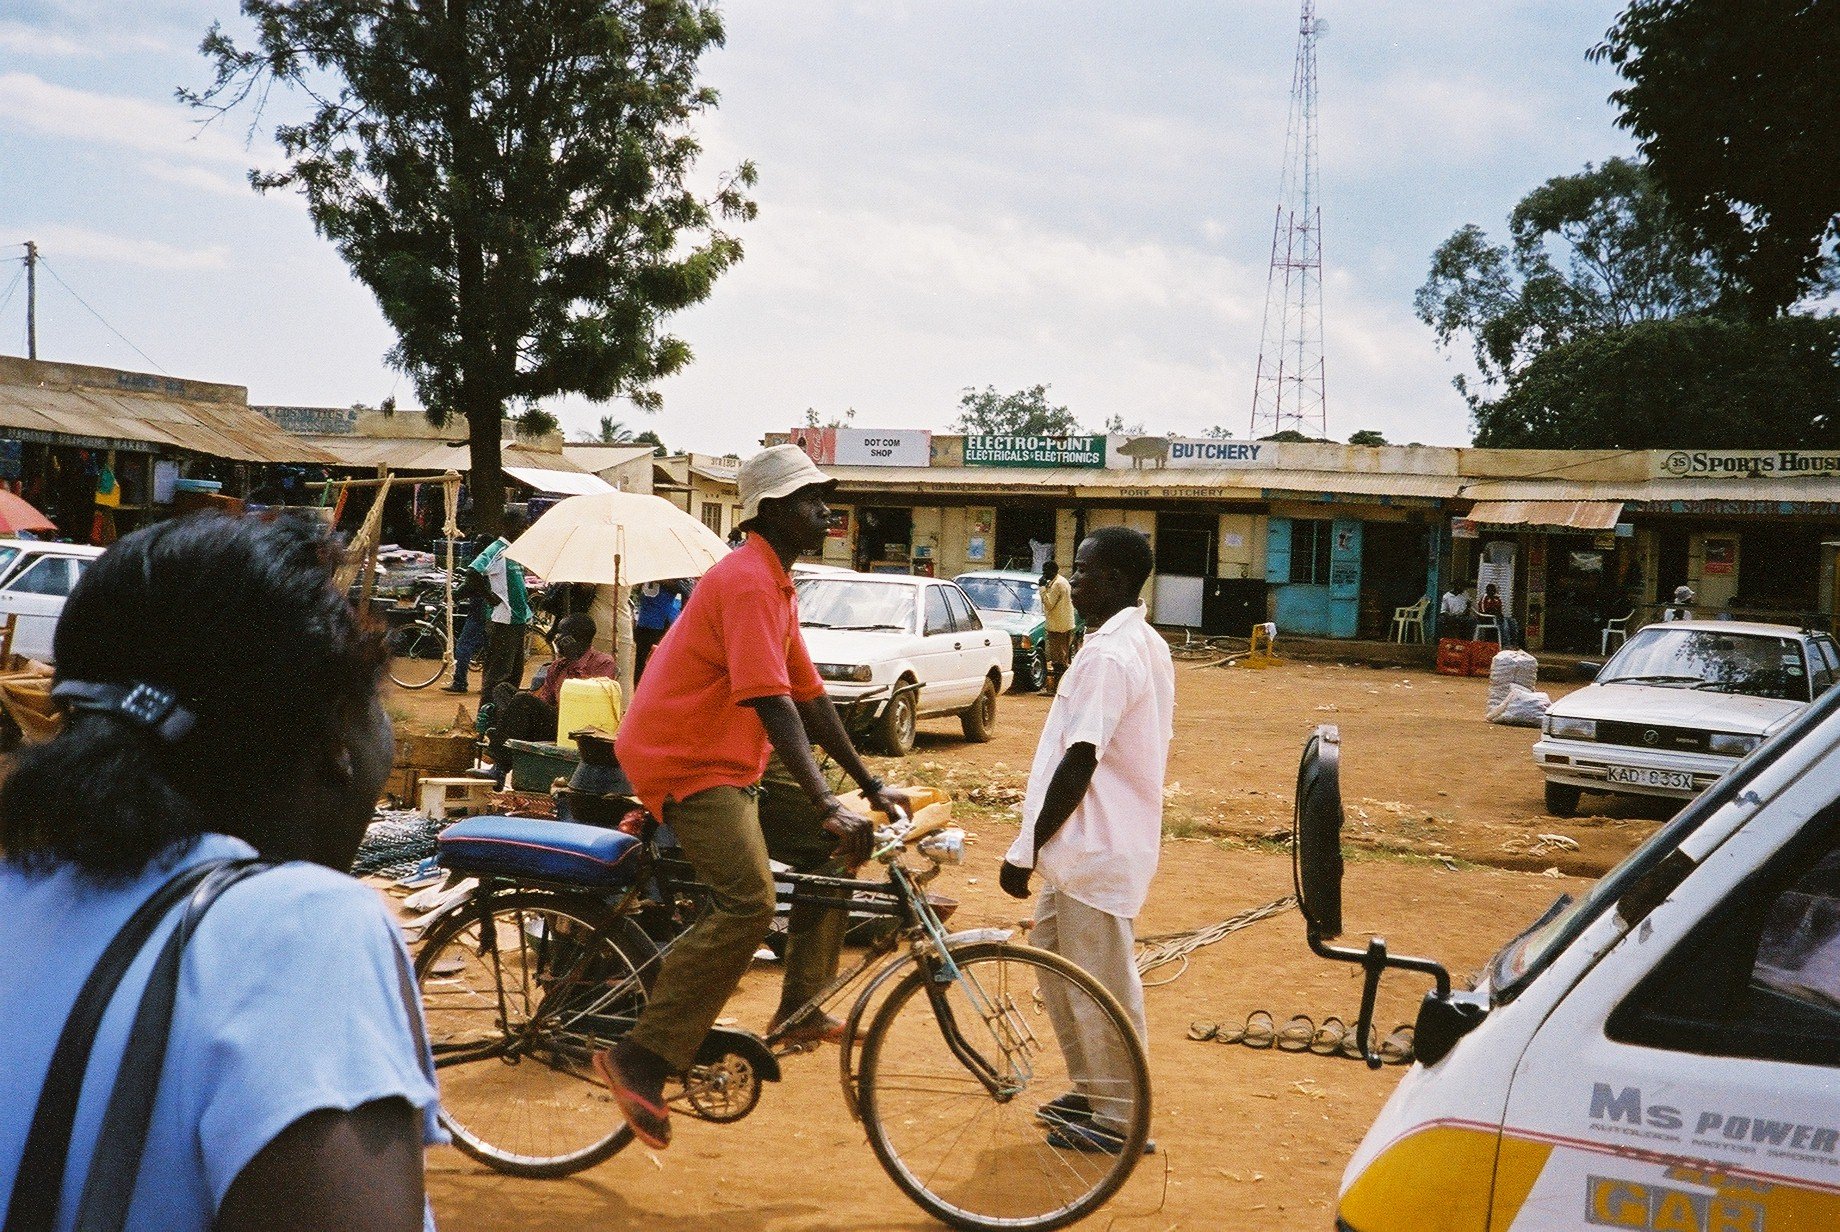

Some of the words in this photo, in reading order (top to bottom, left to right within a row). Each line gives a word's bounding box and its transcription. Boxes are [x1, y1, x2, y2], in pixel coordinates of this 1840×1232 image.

[864, 439, 881, 447] DOT
[883, 439, 900, 447] COM
[870, 449, 893, 457] SHOP
[966, 450, 1029, 461] ELECTRICALS
[1034, 452, 1100, 463] ELECTRONICS
[1172, 443, 1261, 460] BUTCHERY
[1120, 488, 1150, 497] PORK
[1162, 488, 1224, 497] BUTCHERY
[1607, 767, 1640, 782] KAD
[1649, 770, 1693, 788] 833X
[1694, 1110, 1840, 1153] POWER
